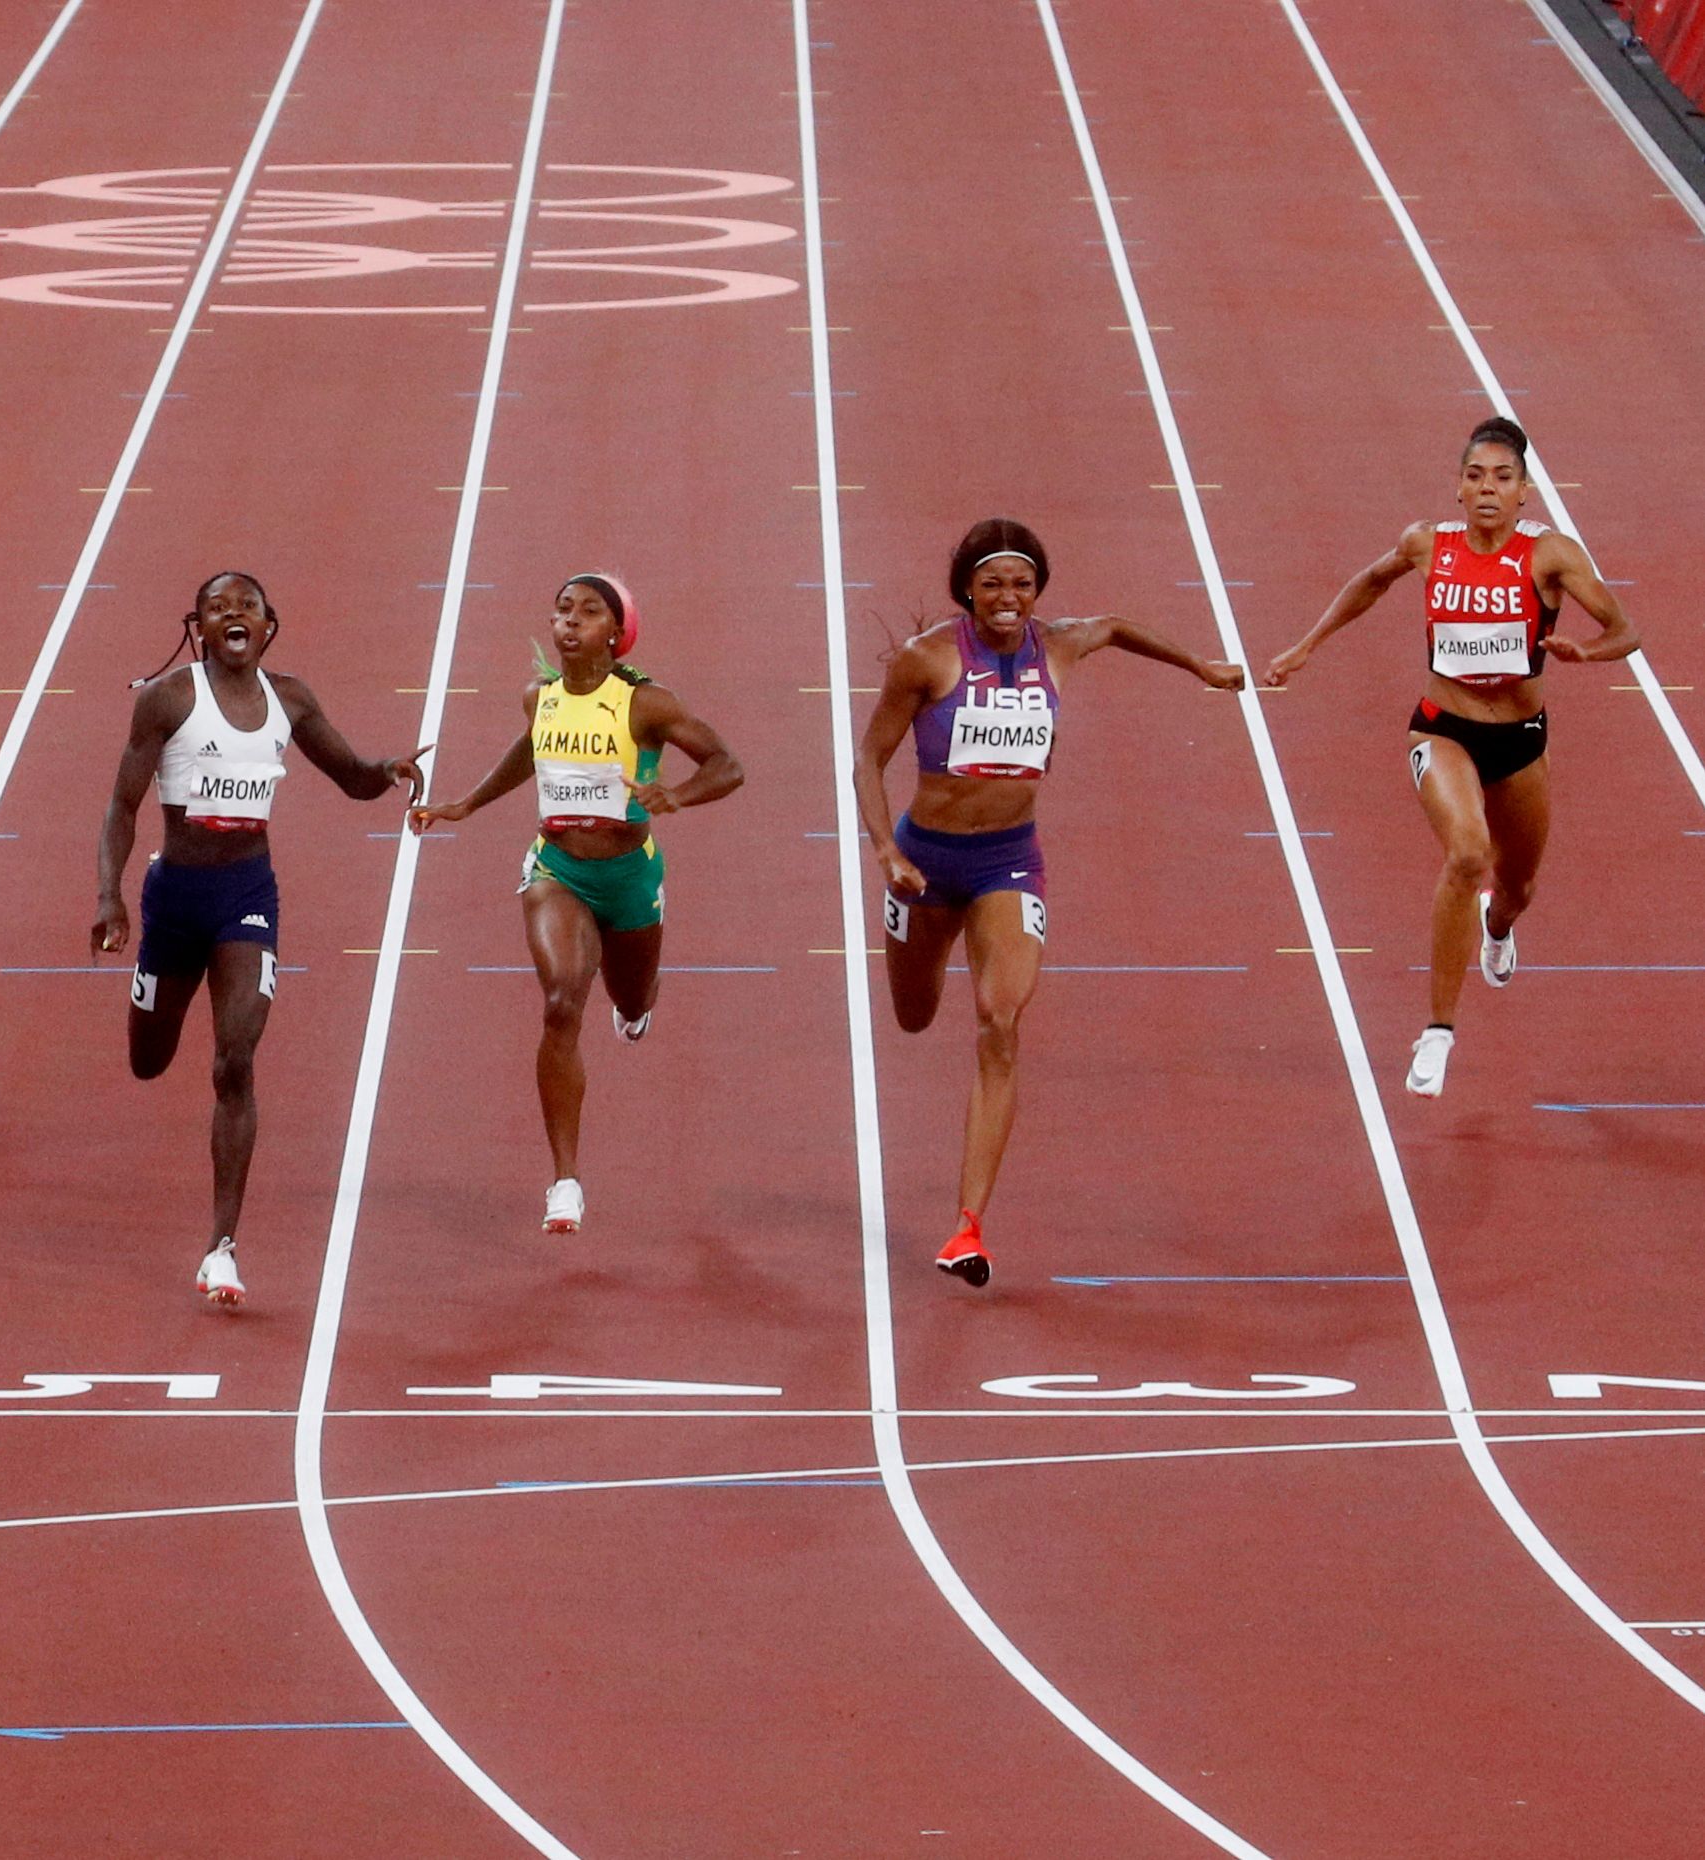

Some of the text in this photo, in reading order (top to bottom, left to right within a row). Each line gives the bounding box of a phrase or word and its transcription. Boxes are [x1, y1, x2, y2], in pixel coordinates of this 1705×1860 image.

[1431, 581, 1523, 615] SUISSE
[1437, 636, 1524, 657] KAMBUNDJI
[966, 685, 1048, 709] USA
[536, 730, 619, 756] JAMAICA
[959, 723, 1049, 748] THOMAS
[1412, 749, 1425, 782] 2
[886, 898, 901, 933] 3
[1031, 901, 1045, 937] 3
[406, 1374, 783, 1399] 4
[980, 1374, 1357, 1399] 3
